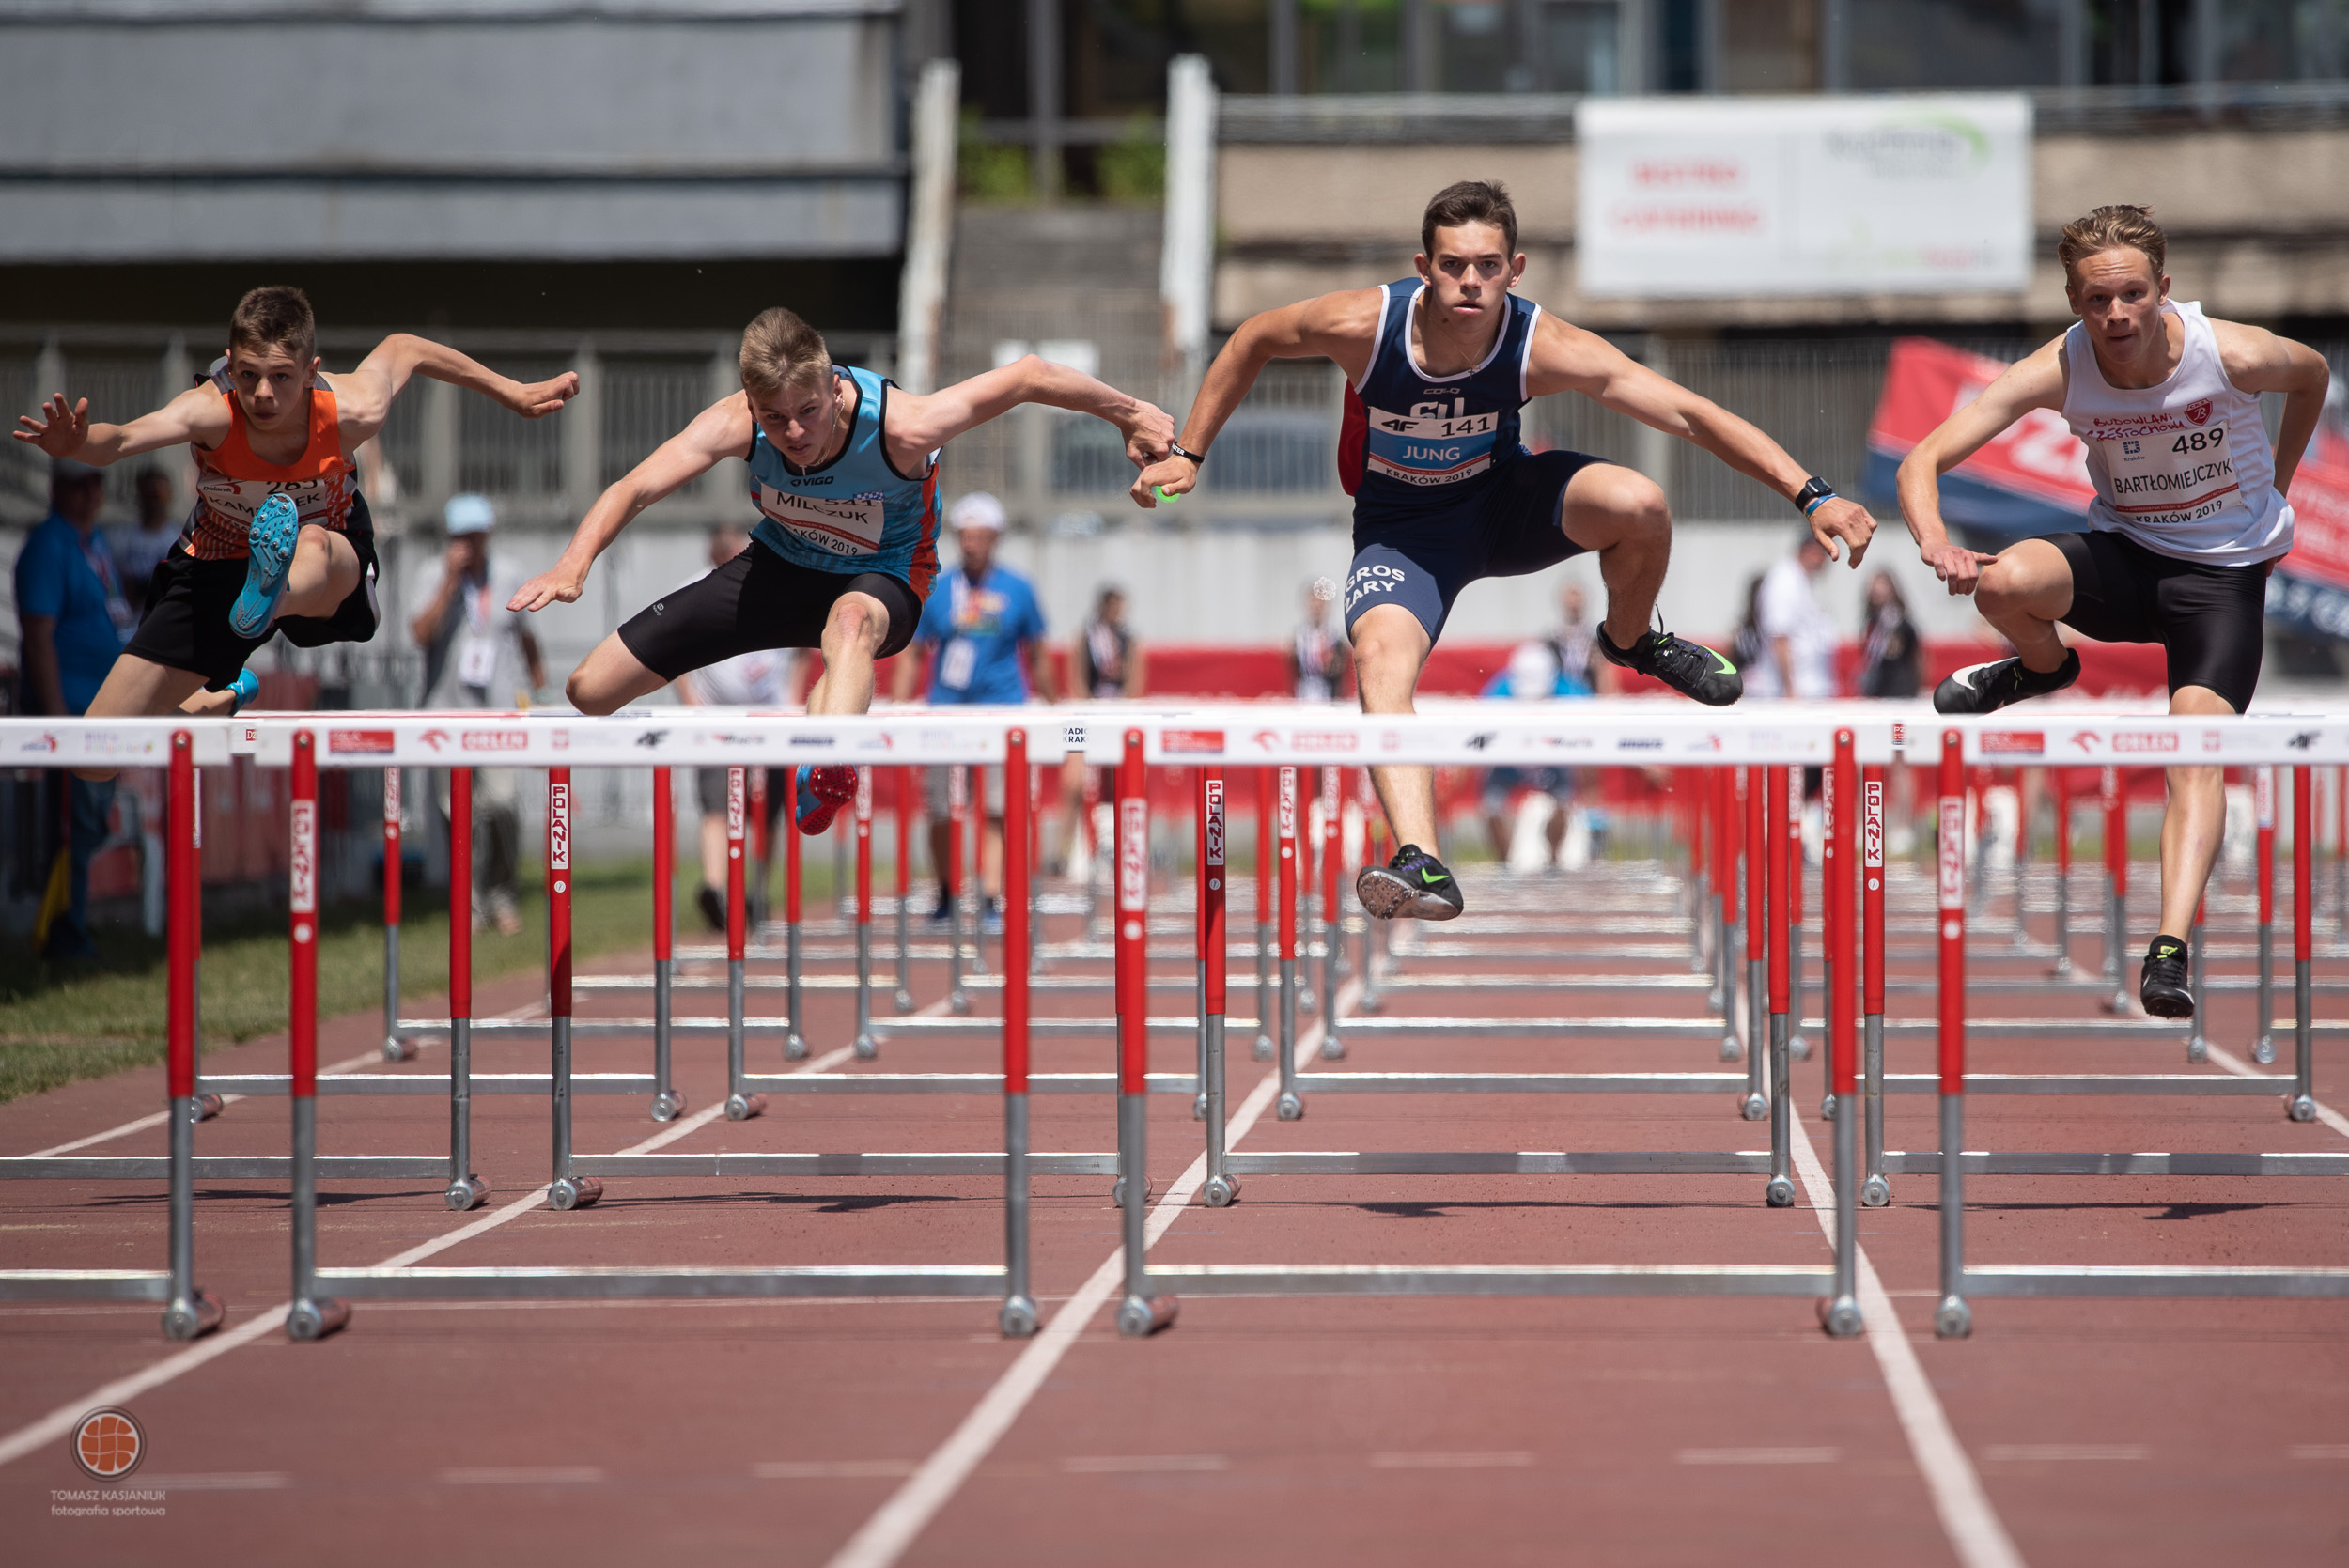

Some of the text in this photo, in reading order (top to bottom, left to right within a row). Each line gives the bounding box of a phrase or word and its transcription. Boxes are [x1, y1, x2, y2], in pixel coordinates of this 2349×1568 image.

[1440, 416, 1490, 438] 141
[2171, 427, 2223, 454] 489
[1402, 445, 1460, 461] JUNG
[2123, 455, 2145, 463] Kraków
[1385, 467, 1472, 485] KRAKÓW 2019
[2114, 458, 2232, 494] BARTŁOMIEJCZYK
[203, 485, 233, 493] polanik
[776, 491, 868, 524] MILCZUK
[825, 498, 876, 507] 541
[2136, 500, 2223, 524] KRAKÓW 2019
[831, 538, 858, 555] 2019
[552, 786, 567, 862] POLANIK
[1208, 783, 1222, 859] POLANIK
[1867, 784, 1881, 860] POLANIK
